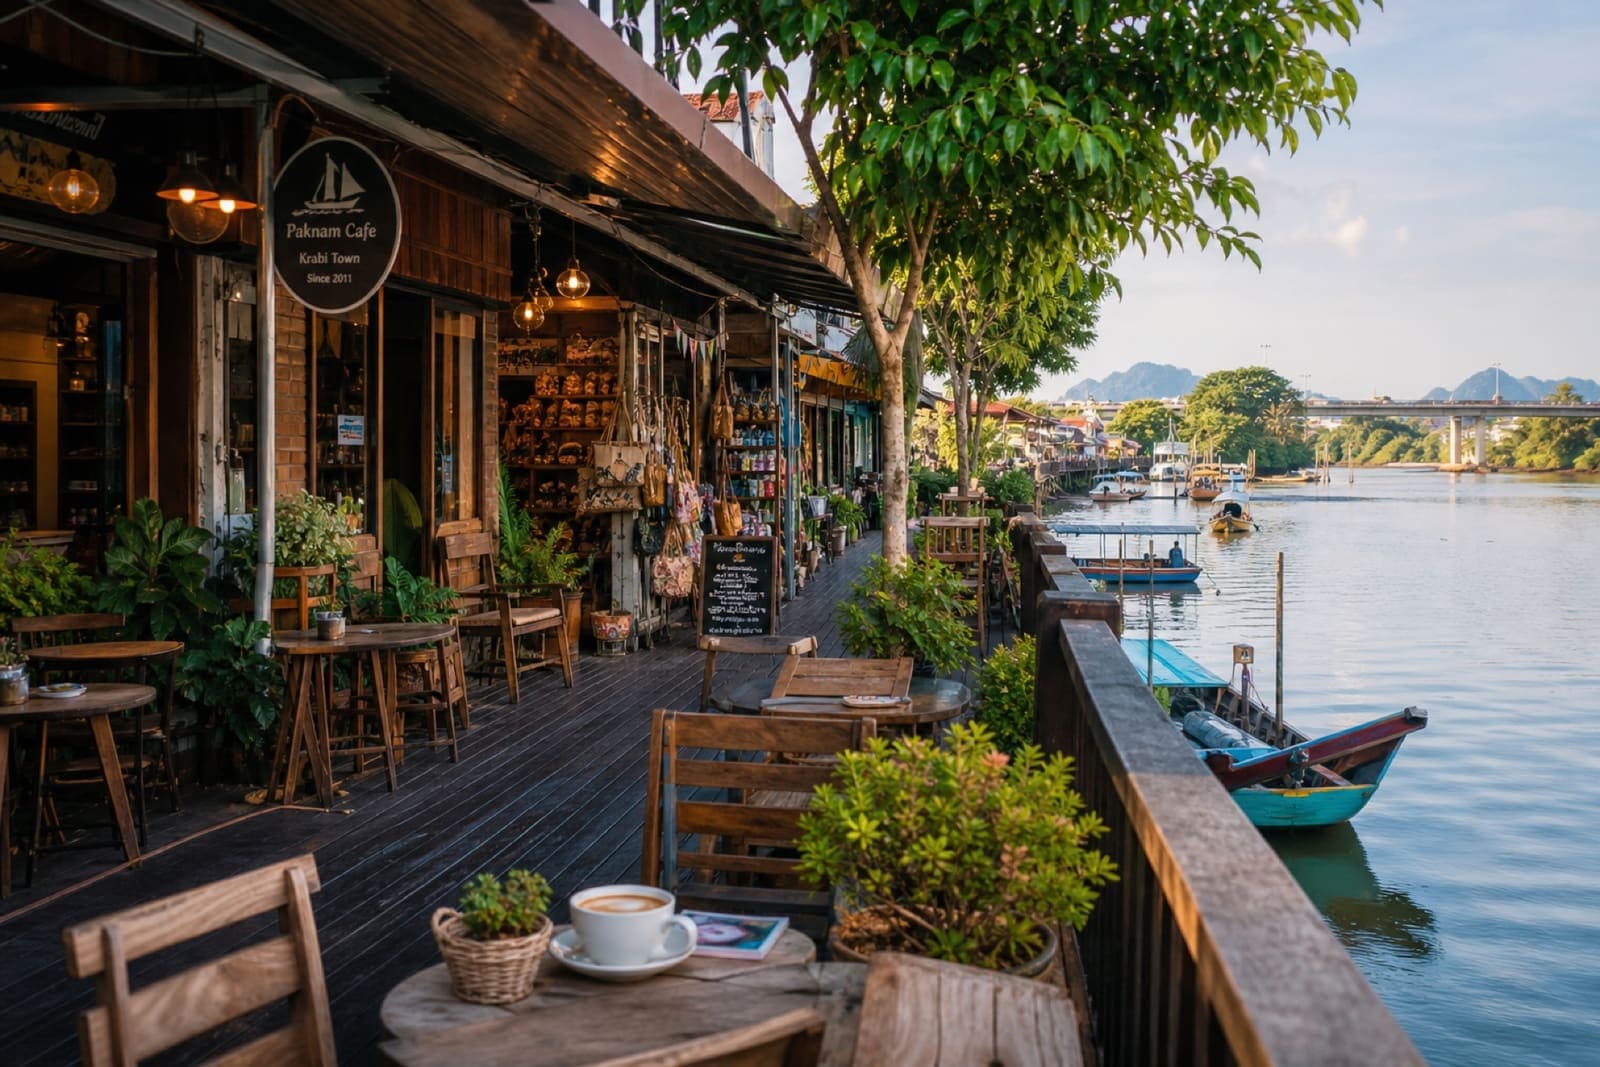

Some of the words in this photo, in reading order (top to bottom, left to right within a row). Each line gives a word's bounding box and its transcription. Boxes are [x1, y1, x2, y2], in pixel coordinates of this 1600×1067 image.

[286, 223, 341, 239] Paknam
[345, 221, 377, 242] Cafe
[299, 252, 328, 264] Krabi
[332, 252, 360, 264] Town
[307, 273, 331, 284] Since
[333, 273, 352, 284] 2011
